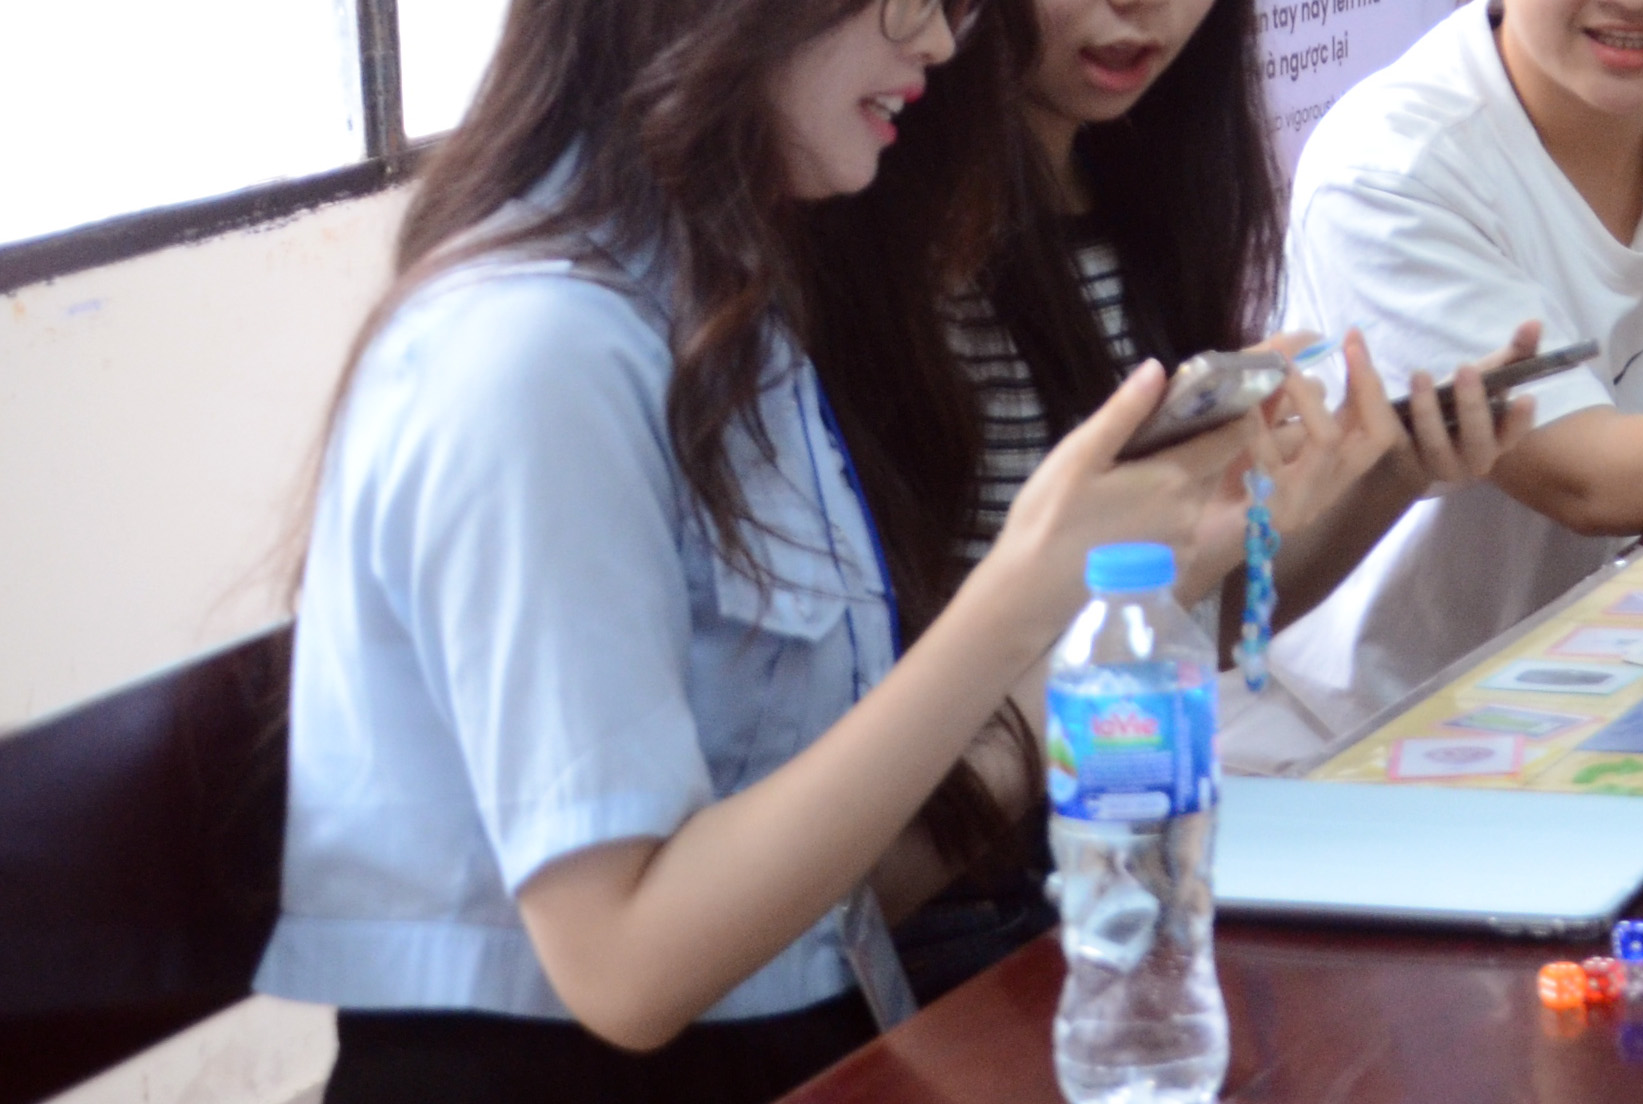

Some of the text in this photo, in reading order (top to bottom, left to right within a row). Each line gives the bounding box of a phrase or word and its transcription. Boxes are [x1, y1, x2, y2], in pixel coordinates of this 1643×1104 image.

[1273, 4, 1297, 34] tay
[1280, 44, 1329, 82] ngược
[1332, 30, 1349, 66] lại
